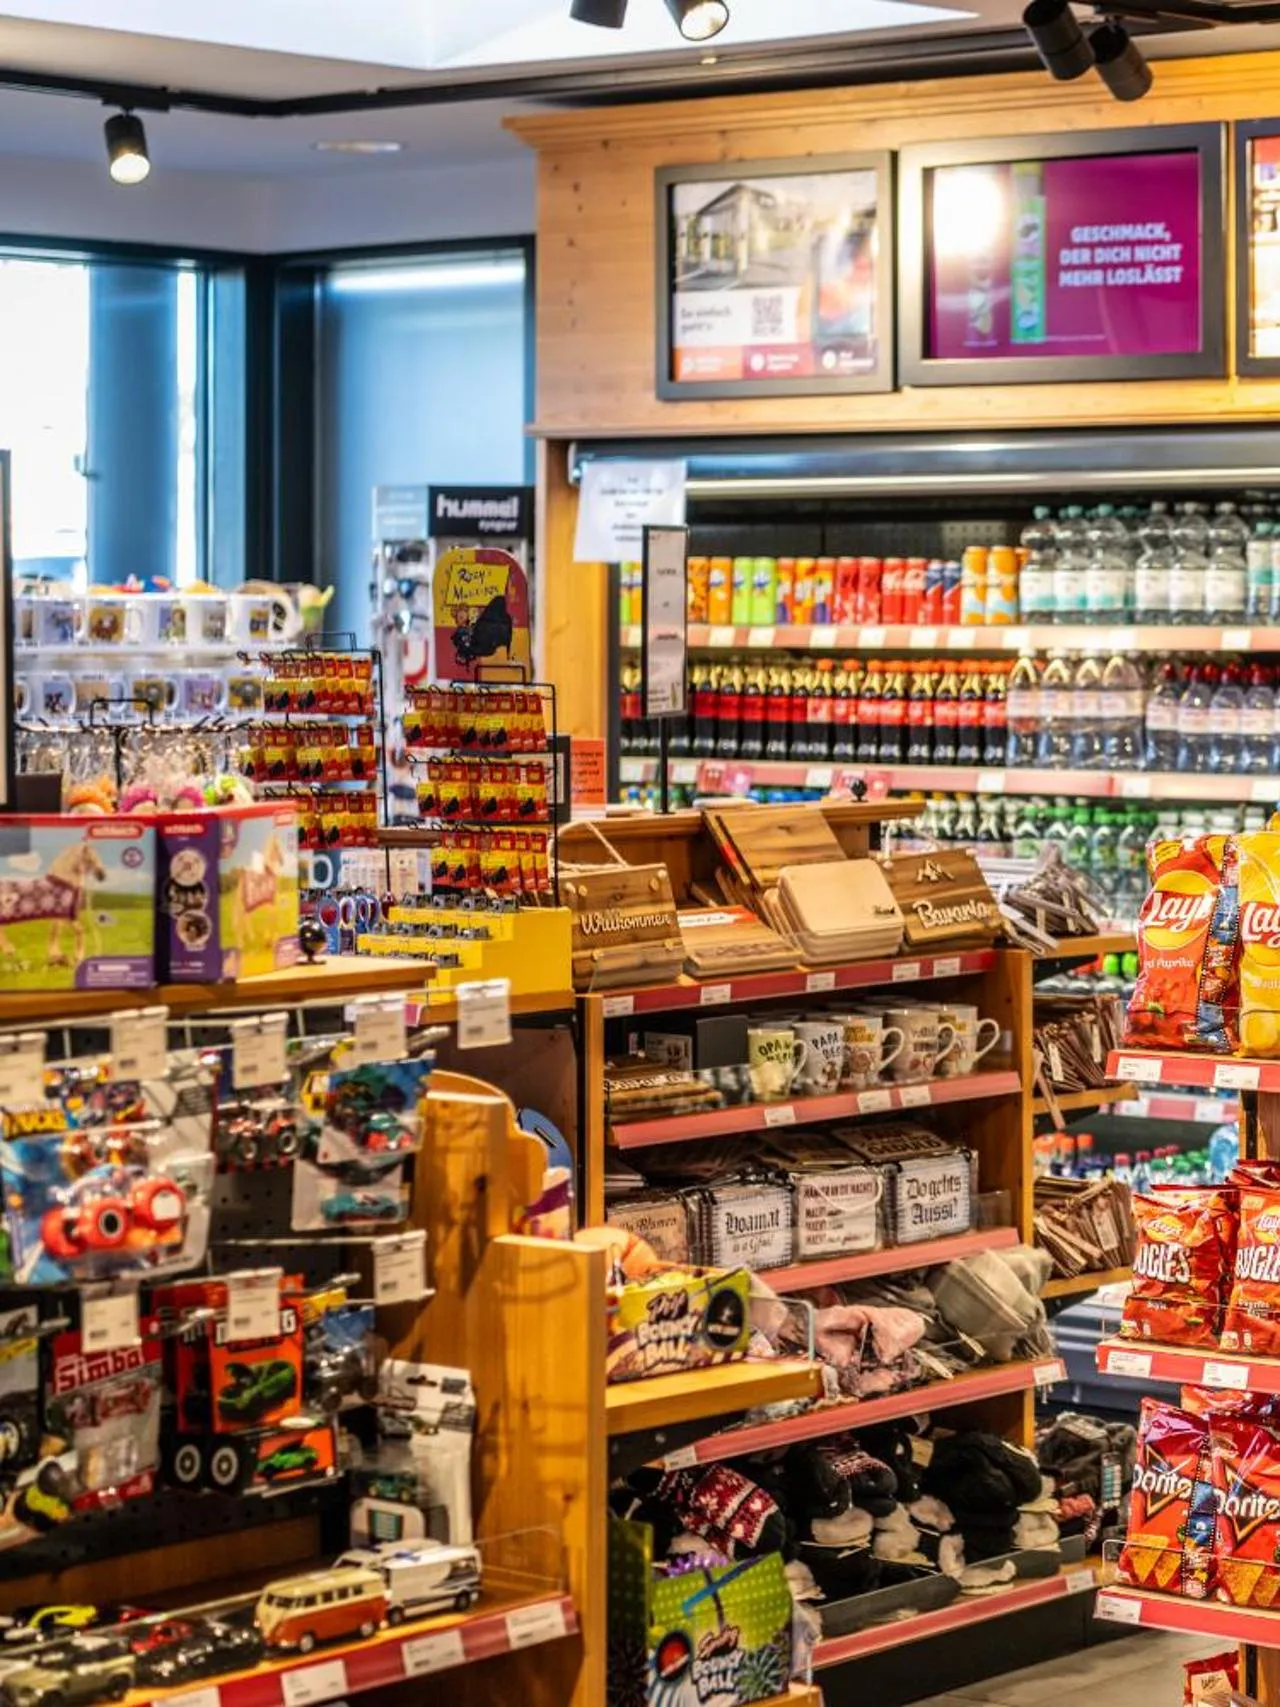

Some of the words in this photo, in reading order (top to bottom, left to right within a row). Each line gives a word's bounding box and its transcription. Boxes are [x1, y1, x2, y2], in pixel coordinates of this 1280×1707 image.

[1070, 222, 1172, 243] GESCHMACK,
[1060, 248, 1092, 265] DER
[1094, 245, 1132, 264] DICH
[1134, 243, 1183, 262] NICHT
[1059, 269, 1104, 286] MEHR
[1106, 264, 1183, 285] LOSLÄSST
[437, 493, 519, 518] hummel
[580, 907, 673, 935] Willkommen
[912, 899, 989, 929] Bavaria
[56, 1349, 143, 1395] Simba
[1133, 1464, 1193, 1500] Dorito
